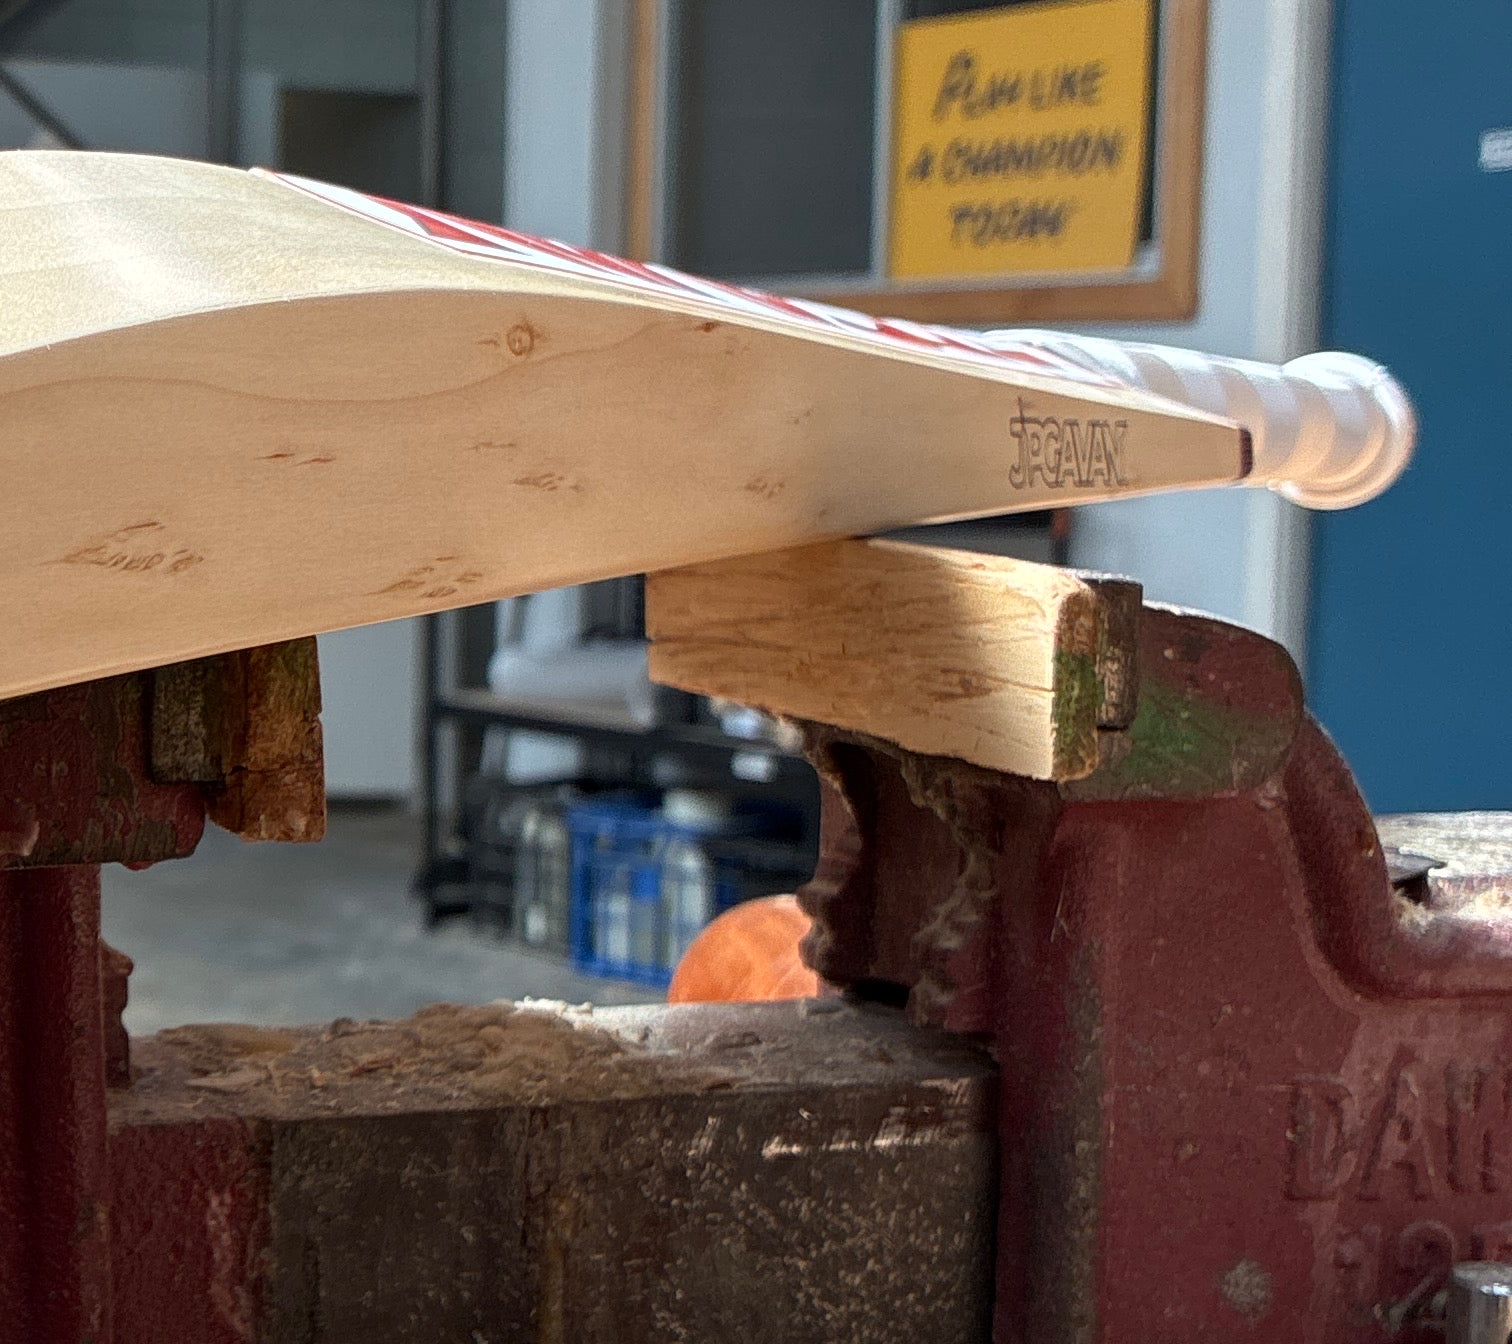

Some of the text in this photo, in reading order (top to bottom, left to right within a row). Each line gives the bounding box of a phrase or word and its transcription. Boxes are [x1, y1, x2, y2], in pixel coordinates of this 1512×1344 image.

[1028, 60, 1106, 112] LIKE
[908, 127, 1124, 185] A CHAMPION
[950, 197, 1076, 247] TODAY
